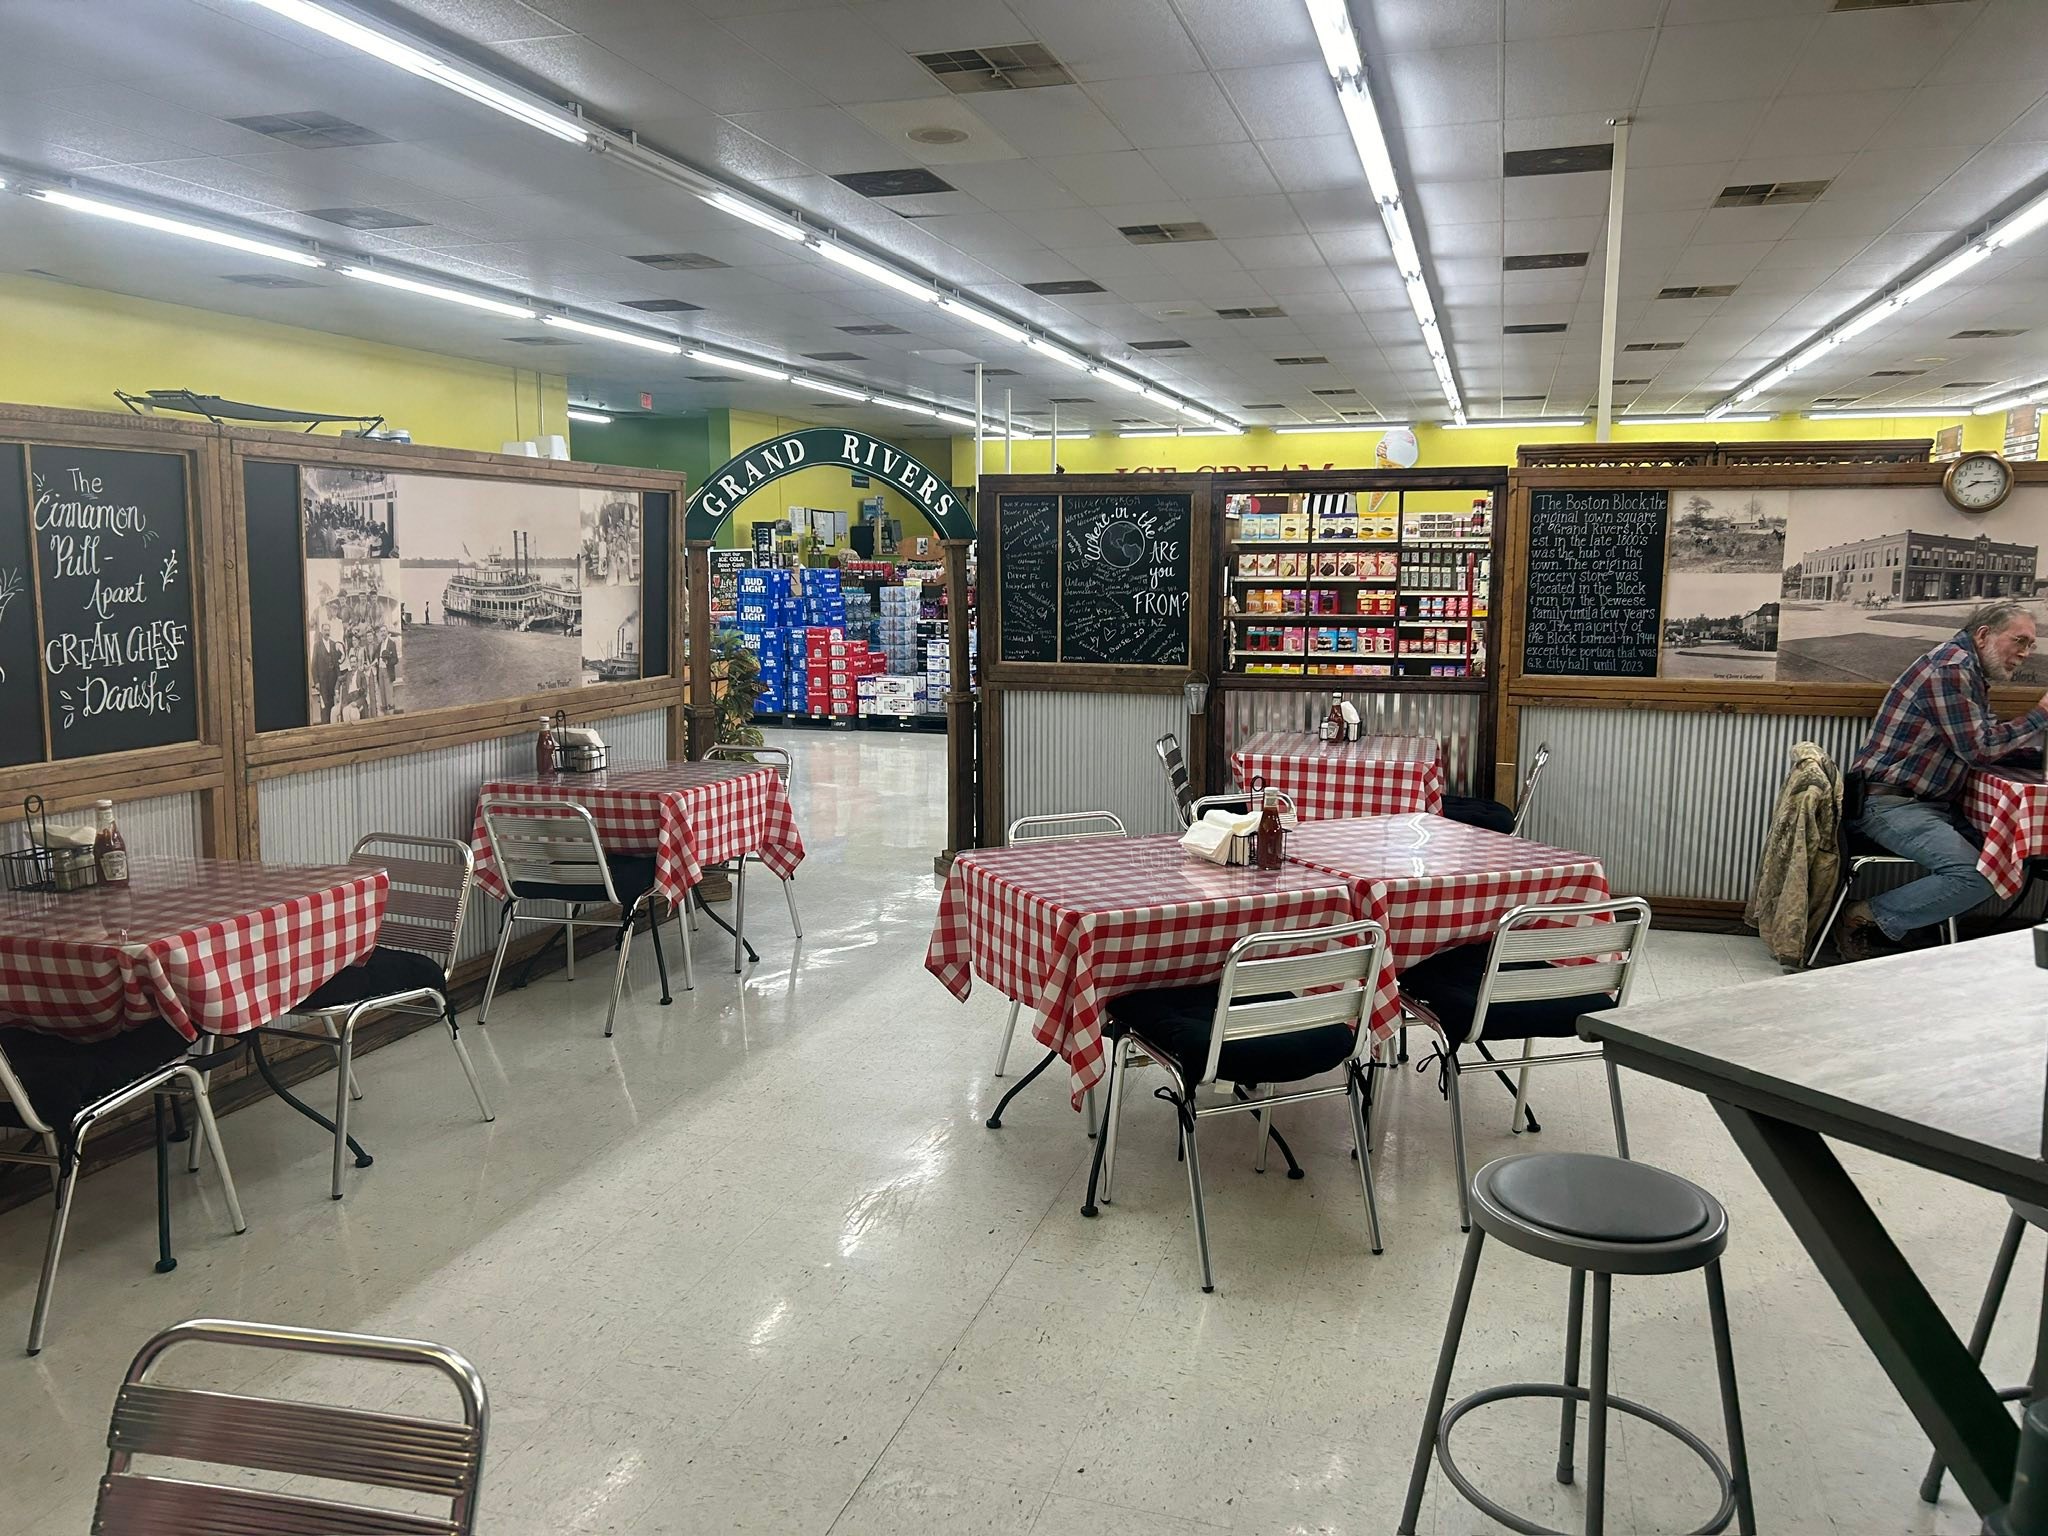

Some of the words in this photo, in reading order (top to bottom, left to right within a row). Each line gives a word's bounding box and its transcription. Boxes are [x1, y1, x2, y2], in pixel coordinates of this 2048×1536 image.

[66, 467, 103, 494] The
[702, 438, 805, 517] GRAND
[841, 434, 955, 516] RIVERS
[1536, 494, 1562, 510] The
[1565, 493, 1609, 510] Boston
[1612, 492, 1649, 511] Block,
[1650, 492, 1667, 510] the
[33, 488, 146, 537] Cinnamon
[1532, 511, 1578, 528] original
[1585, 512, 1613, 523] town
[1617, 512, 1657, 527] square
[1084, 513, 1110, 561] Where
[1115, 502, 1129, 518] in
[1137, 511, 1157, 539] the
[1532, 522, 1544, 535] of
[1553, 523, 1588, 535] Grand
[1554, 535, 1566, 547] in
[1571, 534, 1586, 546] the
[1589, 534, 1612, 546] late
[1149, 541, 1180, 564] ARE
[1531, 547, 1555, 558] was
[1558, 546, 1574, 558] the
[1579, 546, 1600, 558] hub
[1606, 546, 1617, 558] of
[1625, 546, 1643, 557] the
[1532, 559, 1562, 570] town.
[1564, 558, 1588, 570] The
[1592, 558, 1642, 573] original
[744, 577, 763, 585] BUD
[1149, 567, 1175, 589] you
[1530, 571, 1576, 586] grocery
[1580, 569, 1608, 581] store
[1615, 571, 1639, 580] was
[741, 585, 766, 593] LIGHT
[1535, 580, 1575, 594] located
[1579, 584, 1590, 594] in
[1593, 582, 1612, 594] the
[1616, 581, 1647, 594] Block
[83, 574, 147, 619] Apart
[1133, 591, 1189, 617] FROM?
[1536, 596, 1558, 606] run
[1562, 594, 1576, 611] by
[1580, 595, 1595, 606] the
[1600, 594, 1647, 606] Deweese
[740, 612, 766, 621] LIGHT
[744, 605, 763, 613] BUD
[1532, 606, 1568, 621] family
[1569, 607, 1591, 619] until
[1592, 609, 1598, 619] a
[1600, 607, 1619, 619] few
[1624, 608, 1656, 623] years
[1549, 619, 1571, 631] The
[1574, 620, 1628, 634] majority
[1631, 620, 1643, 631] of
[1528, 631, 1543, 643] the
[1547, 631, 1576, 643] Block
[1580, 632, 1616, 643] burned
[1622, 634, 1633, 644] in
[1636, 632, 1656, 644] 1944
[45, 622, 125, 675] CREAM
[1526, 645, 1559, 659] except
[1561, 644, 1577, 656] the
[1580, 646, 1615, 658] portion
[1617, 645, 1637, 657] that
[1639, 647, 1657, 657] was
[1546, 656, 1567, 672] city
[1568, 657, 1589, 670] hall
[1594, 659, 1618, 671] until
[1621, 660, 1644, 671] 2023
[77, 671, 167, 716] Danish
